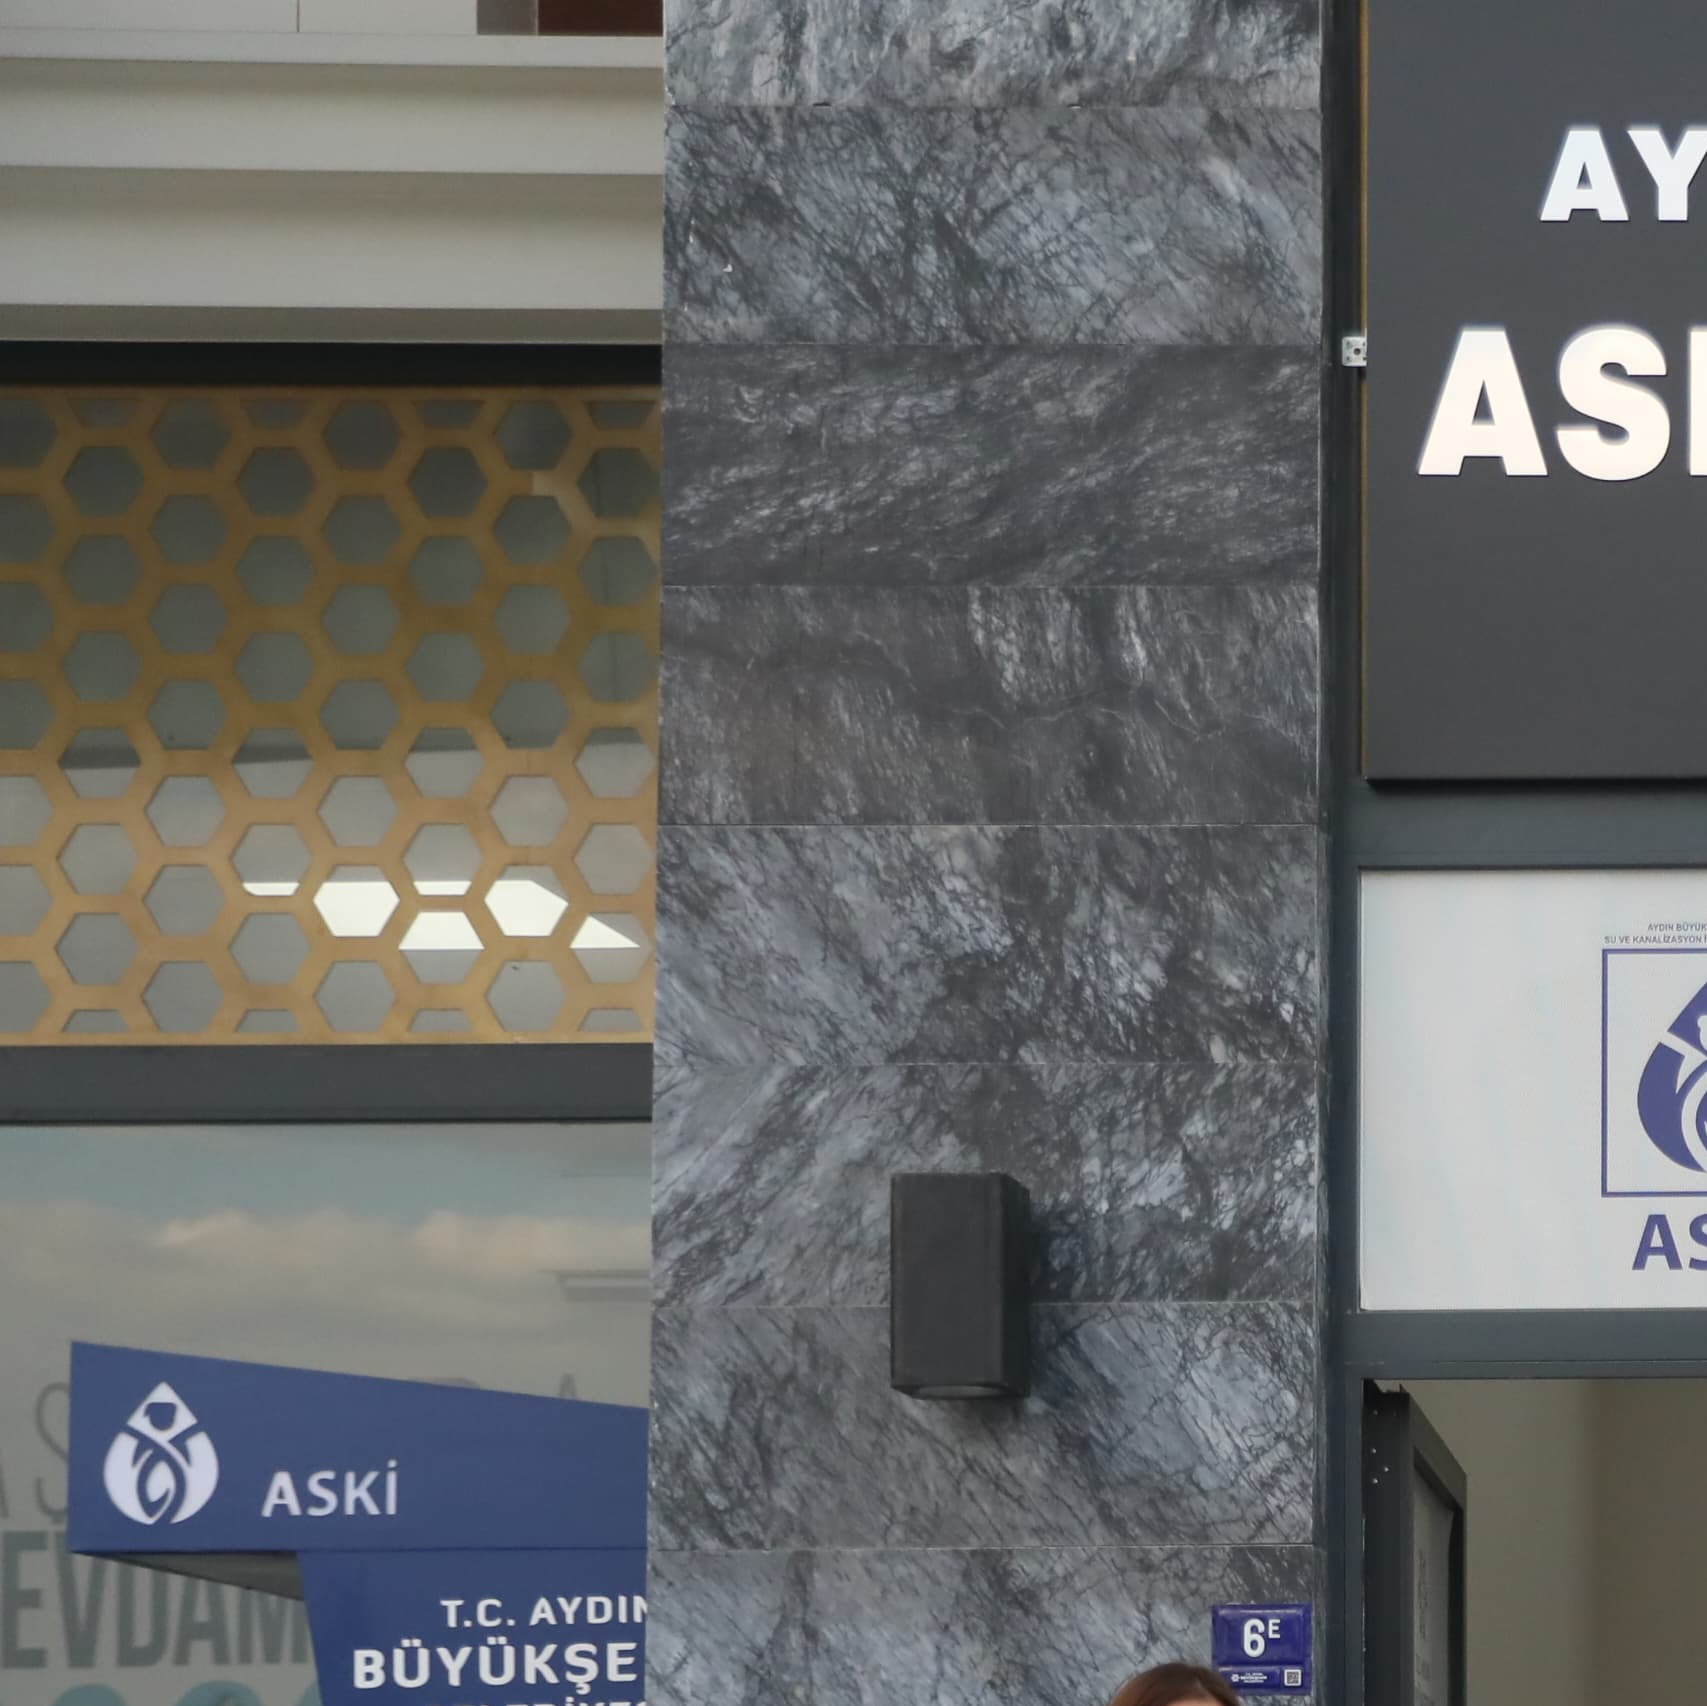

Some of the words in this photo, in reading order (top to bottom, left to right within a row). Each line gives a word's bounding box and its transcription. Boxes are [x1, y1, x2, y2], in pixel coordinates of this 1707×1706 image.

[1619, 935, 1631, 944] VE
[1648, 922, 1674, 932] AYDIN
[261, 1459, 398, 1517] ASKİ
[440, 1597, 516, 1629] T.C.
[1243, 1618, 1281, 1658] 6E
[353, 1635, 638, 1696] BÜYÜKŞE
